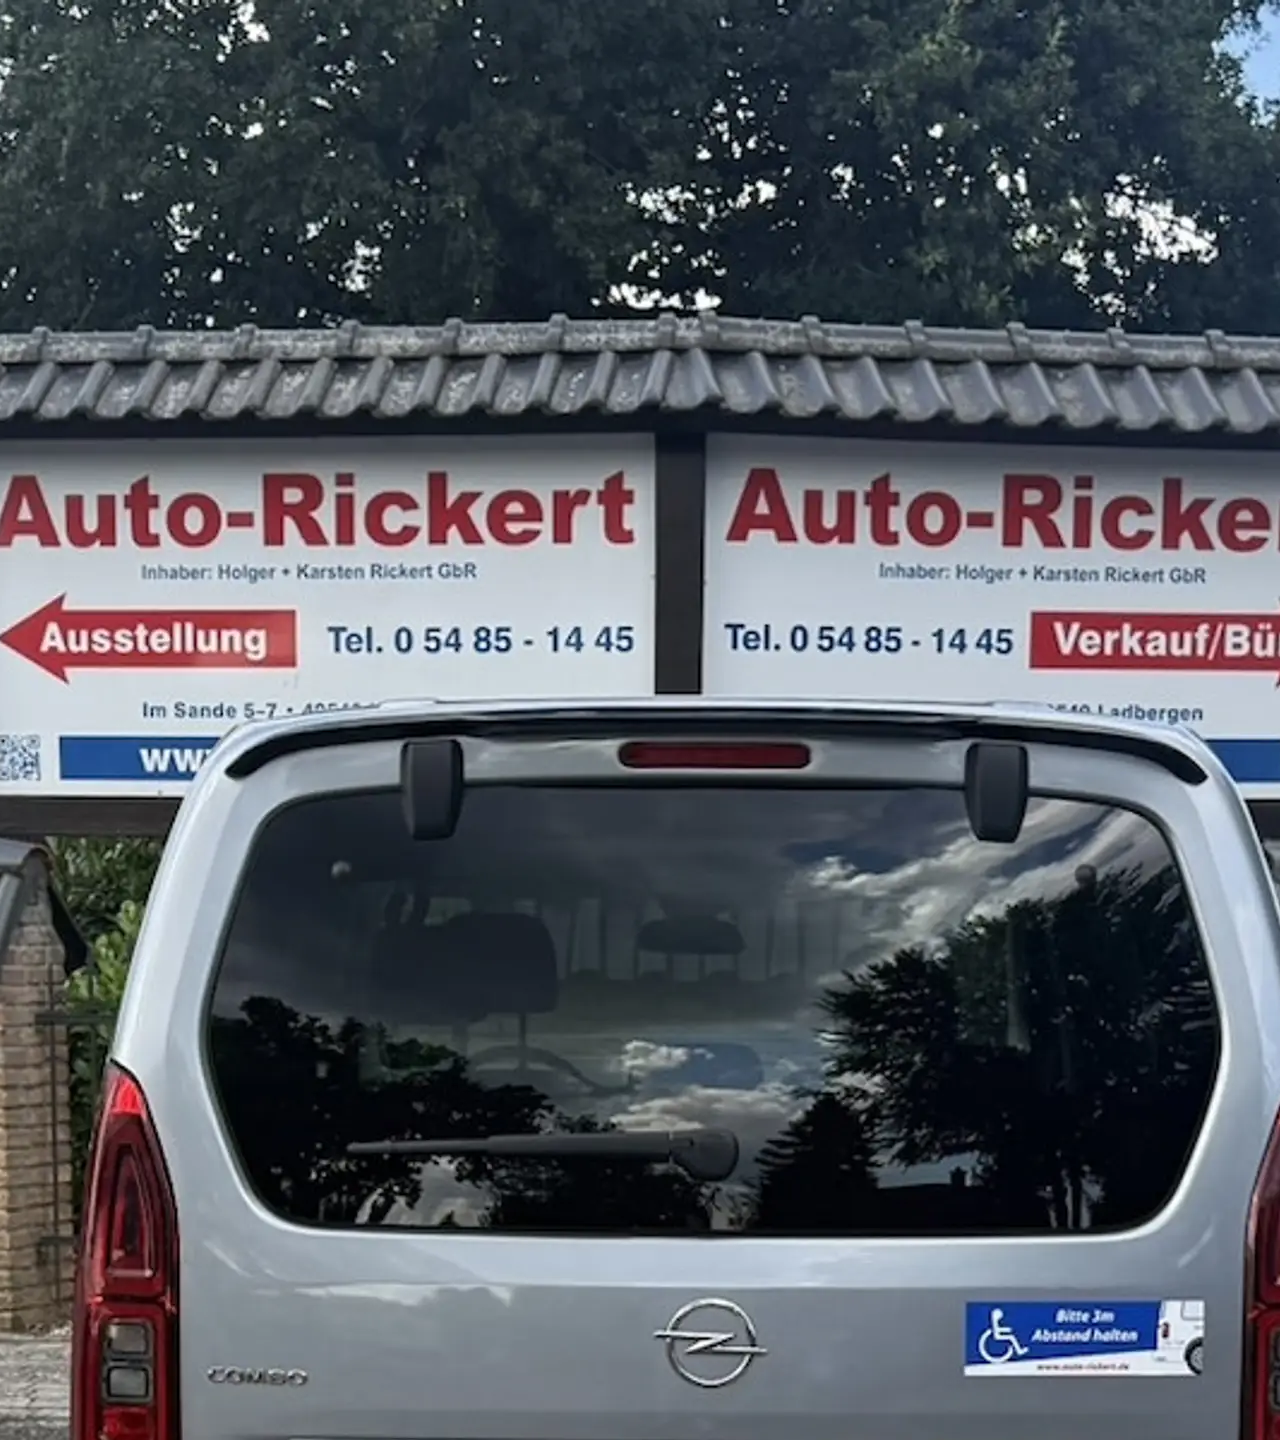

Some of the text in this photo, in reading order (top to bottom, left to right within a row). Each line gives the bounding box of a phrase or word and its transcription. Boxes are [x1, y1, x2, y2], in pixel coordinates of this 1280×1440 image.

[141, 564, 212, 580] Inhaber:
[218, 564, 277, 584] Holger
[297, 563, 365, 580] Karsten
[370, 563, 433, 580] Rickert
[438, 562, 477, 579] GbR
[879, 562, 950, 580] Inhaber:
[956, 564, 1014, 584] Holger
[1033, 565, 1099, 582] Karsten
[1104, 566, 1165, 583] Rickert
[1170, 566, 1207, 583] GbR
[39, 621, 269, 662] Ausstellung
[327, 625, 383, 653] Tel.
[394, 626, 413, 653] 0
[423, 626, 463, 653] 54
[473, 626, 513, 653] 85
[546, 626, 585, 653] 14
[594, 625, 635, 652] 45
[723, 623, 781, 651] Tel.
[790, 625, 809, 652] 0
[817, 625, 856, 652] 54
[863, 626, 903, 653] 85
[931, 628, 968, 654] 14
[975, 627, 1015, 655] 45
[142, 703, 167, 718] Im
[174, 702, 237, 719] Sande
[1055, 1308, 1115, 1324] Bitte 3m
[1031, 1328, 1138, 1343] Abstand halten
[206, 1365, 309, 1386] COMBO
